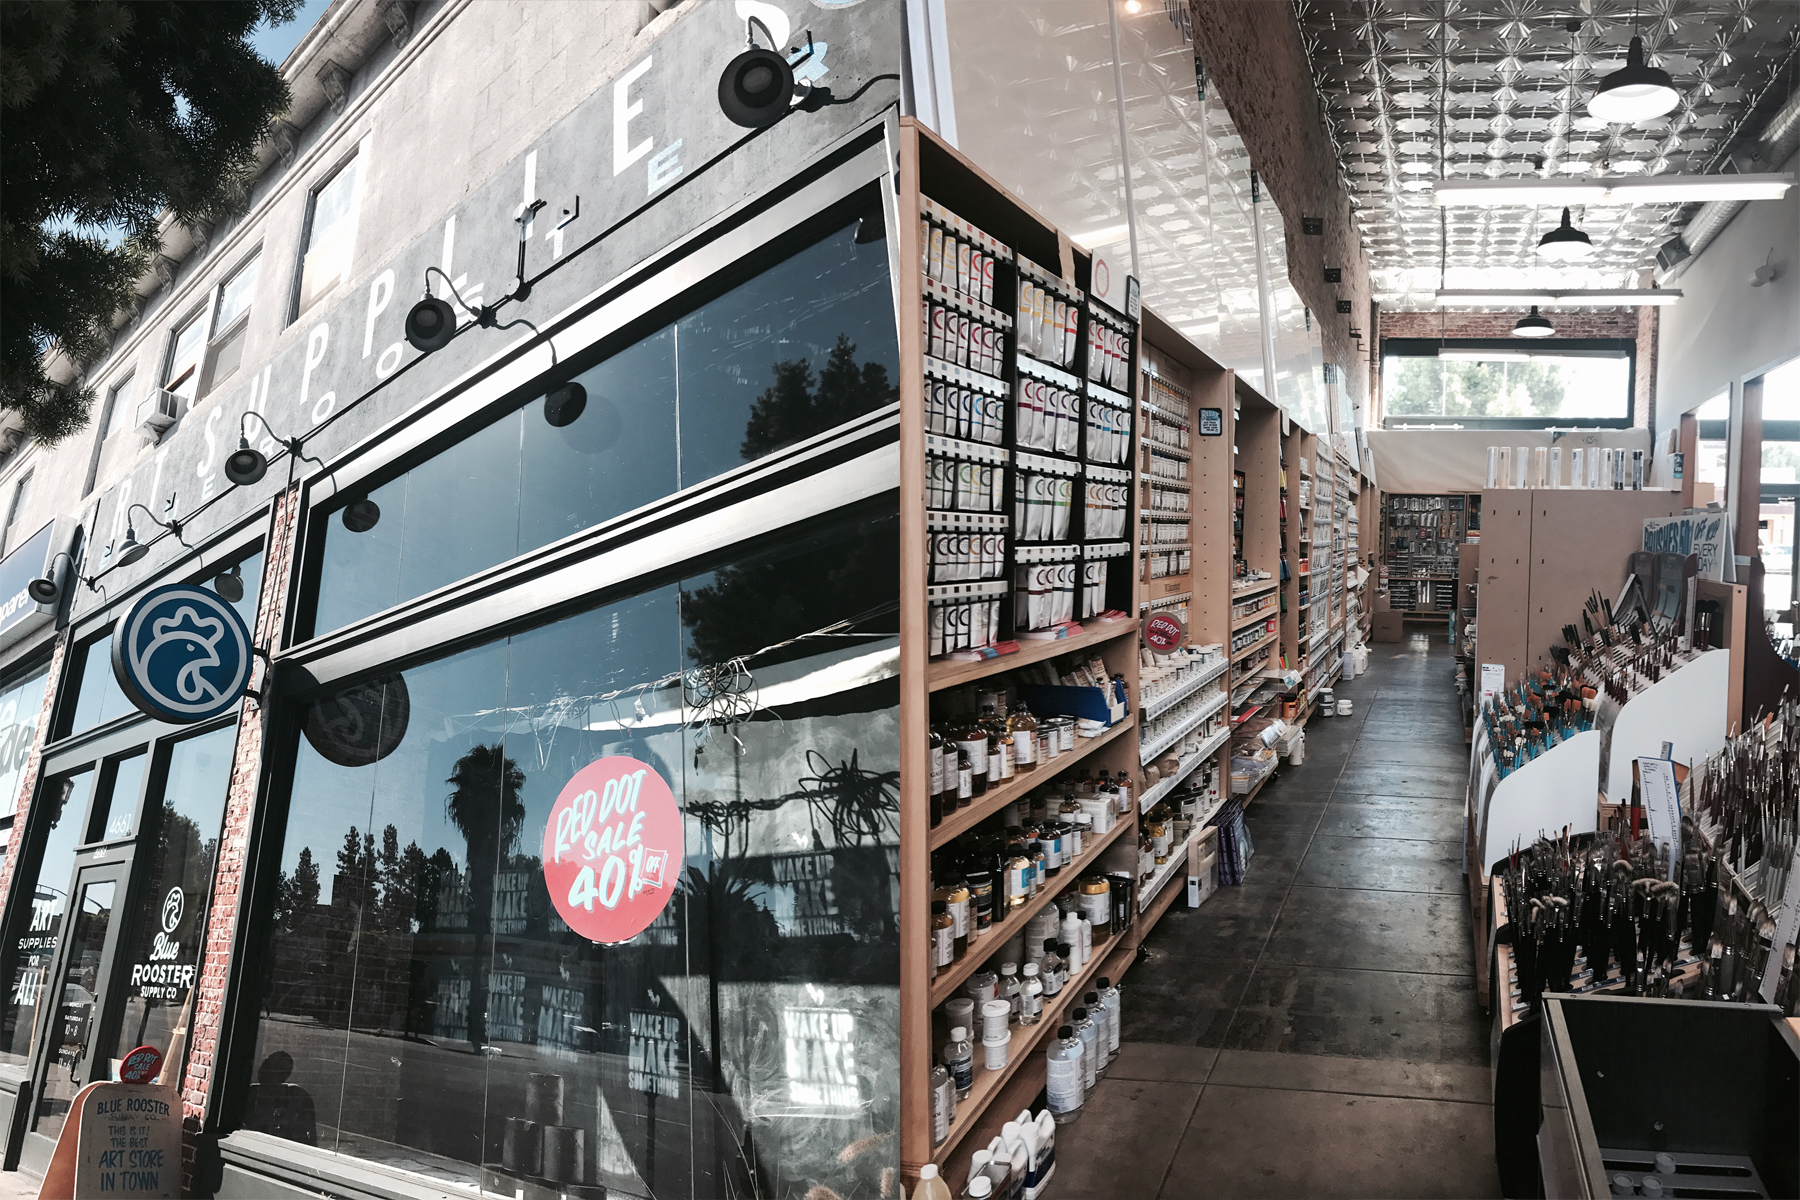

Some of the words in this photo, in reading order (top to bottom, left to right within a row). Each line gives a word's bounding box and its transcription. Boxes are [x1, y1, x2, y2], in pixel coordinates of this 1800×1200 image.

[1693, 543, 1719, 557] EVERY
[1697, 556, 1714, 573] DAY
[1150, 619, 1169, 629] RED
[1165, 624, 1180, 636] DOT
[109, 813, 132, 835] 4661
[555, 790, 598, 865] RED
[599, 769, 648, 825] DOT
[582, 811, 647, 861] SALE
[568, 843, 644, 913] 40%
[645, 855, 662, 874] OFF
[772, 856, 813, 882] WAKE
[815, 854, 835, 879] UP
[29, 899, 58, 932] ART
[18, 936, 58, 950] SUPPLIES
[149, 931, 180, 962] Blue
[28, 955, 40, 967] FOR
[131, 964, 194, 989] ROOSTER
[488, 973, 513, 995] WAKE
[514, 975, 526, 994] UP
[14, 972, 39, 1007] ALL
[140, 985, 166, 999] SUPPLY
[166, 986, 177, 999] CO
[542, 985, 569, 1010] WAKE
[570, 990, 584, 1012] UP
[64, 1014, 83, 1023] SATURDAY
[486, 993, 525, 1027] MAKE
[629, 1012, 662, 1039] WAKE
[664, 1015, 680, 1041] UP
[784, 1010, 830, 1041] WAKE
[831, 1013, 853, 1042] UP
[127, 1053, 145, 1067] RED
[144, 1053, 159, 1065] DOT
[133, 1062, 151, 1071] SALE
[628, 1035, 680, 1078] MAKE
[628, 1071, 679, 1099] SOMETHING
[97, 1099, 122, 1115] BLUE
[126, 1098, 170, 1116] ROOSTER
[108, 1125, 126, 1136] THIS
[129, 1125, 136, 1136] IS
[110, 1138, 127, 1148] THE
[129, 1138, 149, 1148] BEST
[98, 1150, 126, 1169] ART
[129, 1149, 164, 1169] STORE
[100, 1171, 115, 1192] IN
[120, 1170, 159, 1192] TOWN
